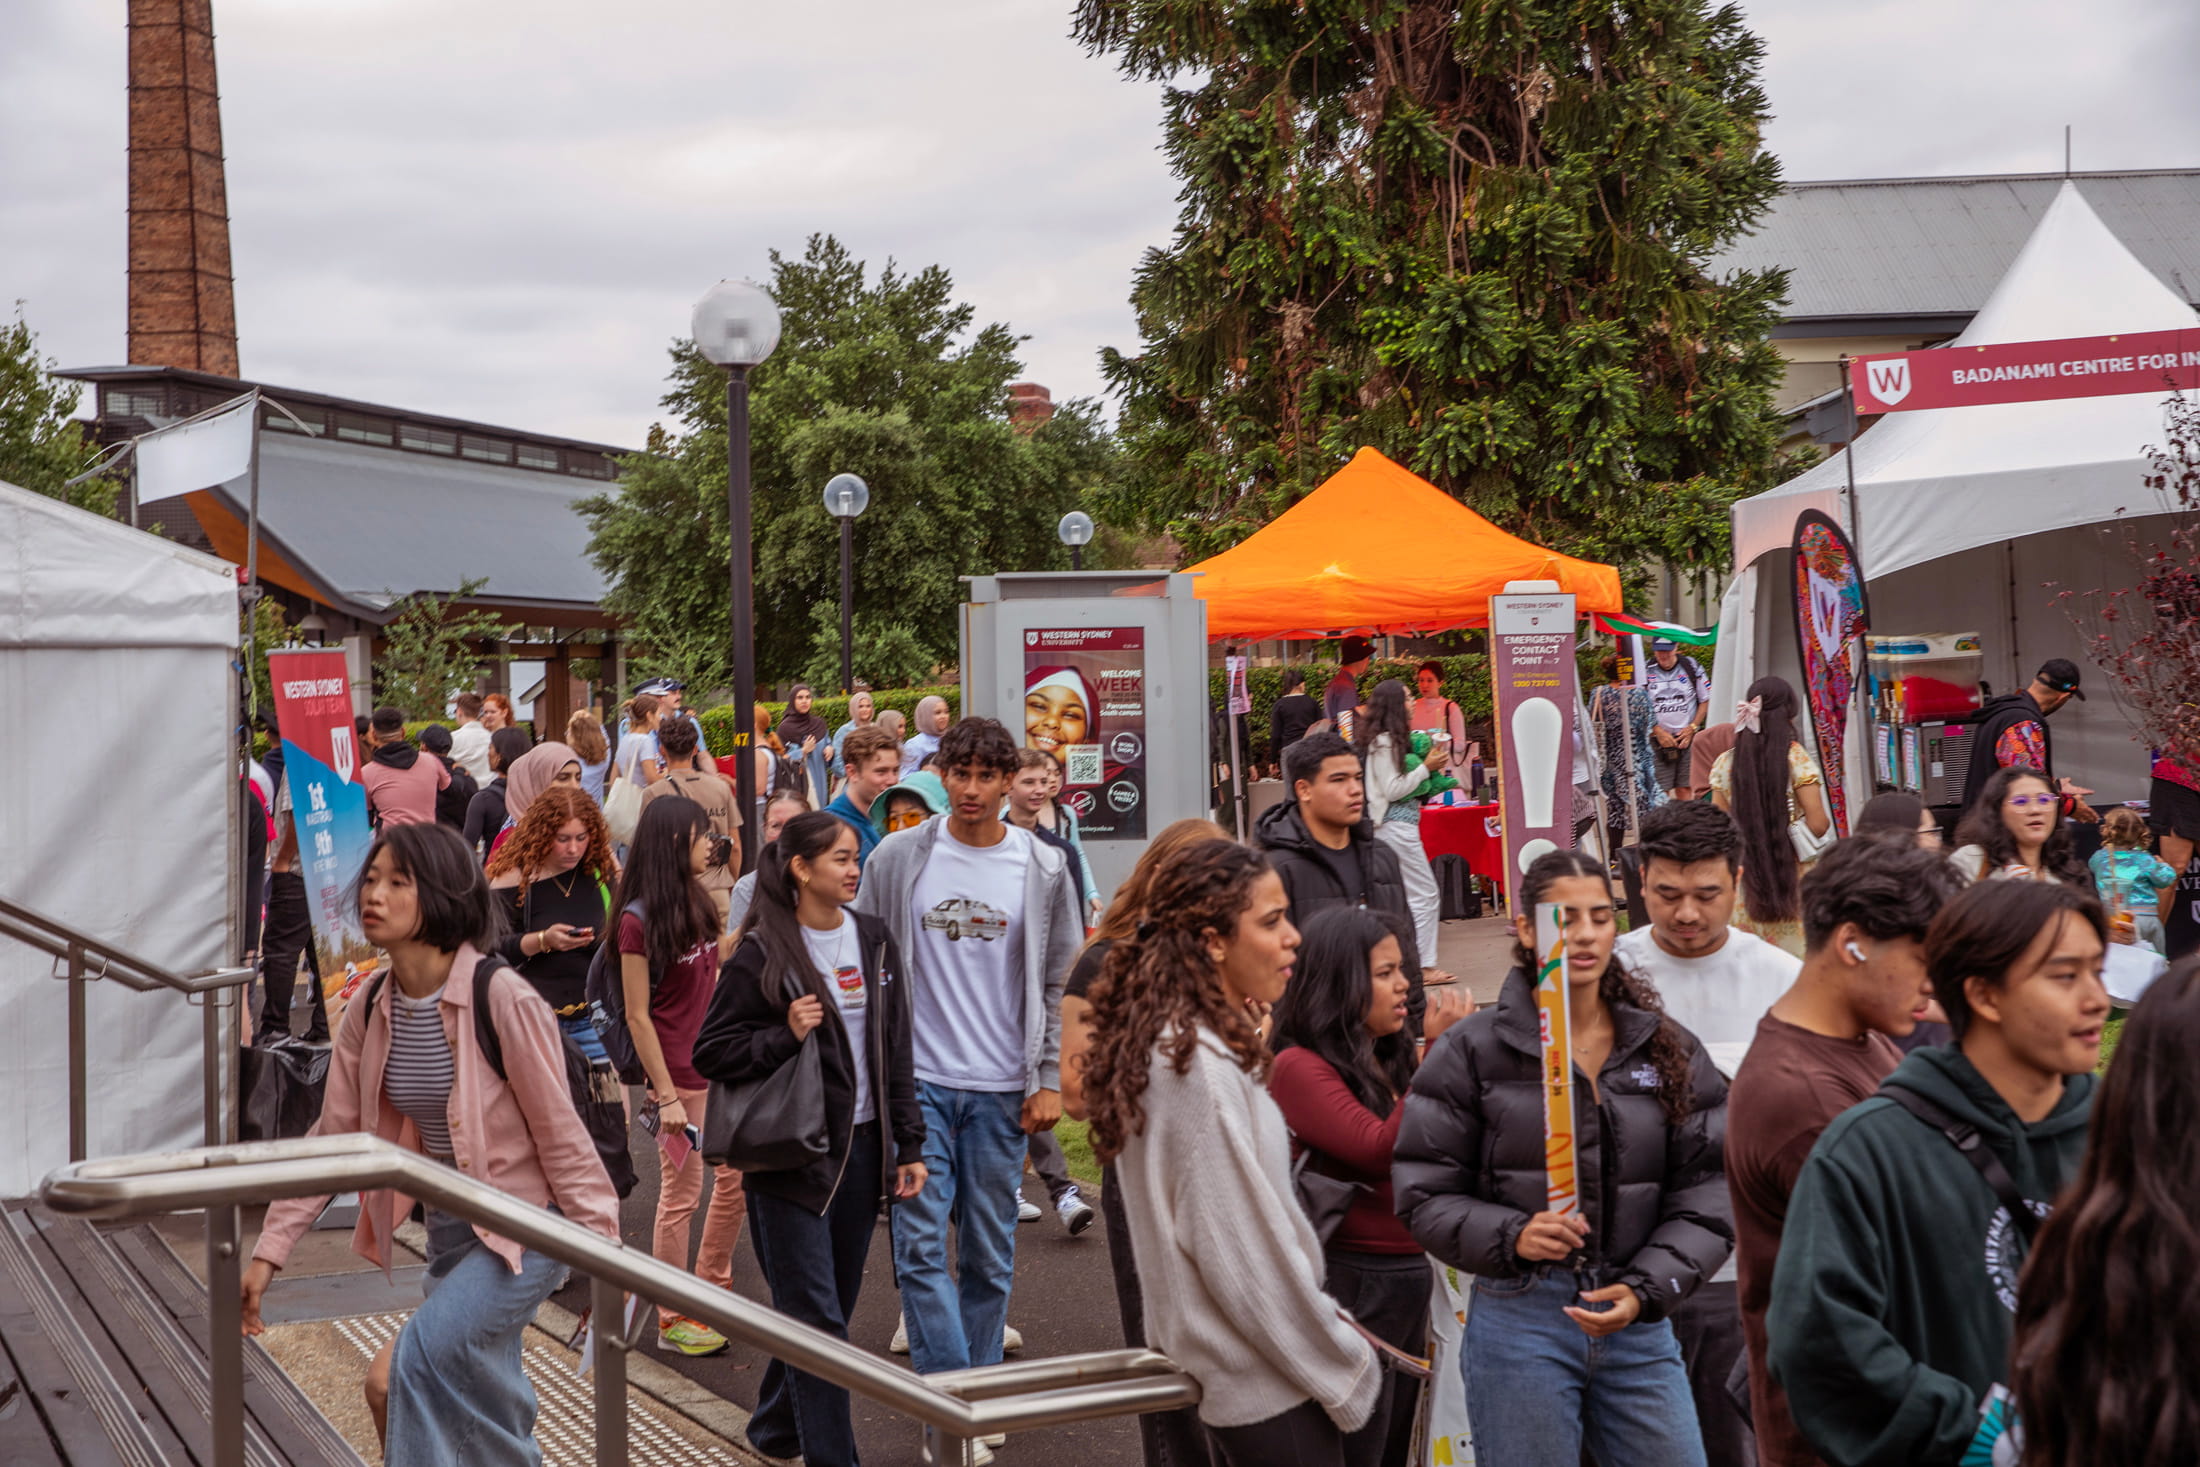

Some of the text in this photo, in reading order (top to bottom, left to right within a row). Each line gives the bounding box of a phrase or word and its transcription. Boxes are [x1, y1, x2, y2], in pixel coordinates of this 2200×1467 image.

[1952, 362, 2056, 384] BADANAMI
[2059, 356, 2135, 377] CENTRE
[2137, 352, 2179, 370] FOR
[1872, 365, 1903, 393] W
[1041, 630, 1113, 640] WESTERN SYDNEY
[1504, 635, 1567, 645] EMERGENCY
[1512, 645, 1560, 655] CONTACT
[1512, 656, 1543, 665] POINT
[1099, 669, 1142, 678] WELCOME
[282, 678, 344, 699] WESTERN SYDNEY
[1093, 677, 1141, 691] WEEK
[333, 735, 350, 769] W
[308, 782, 327, 811] 1st
